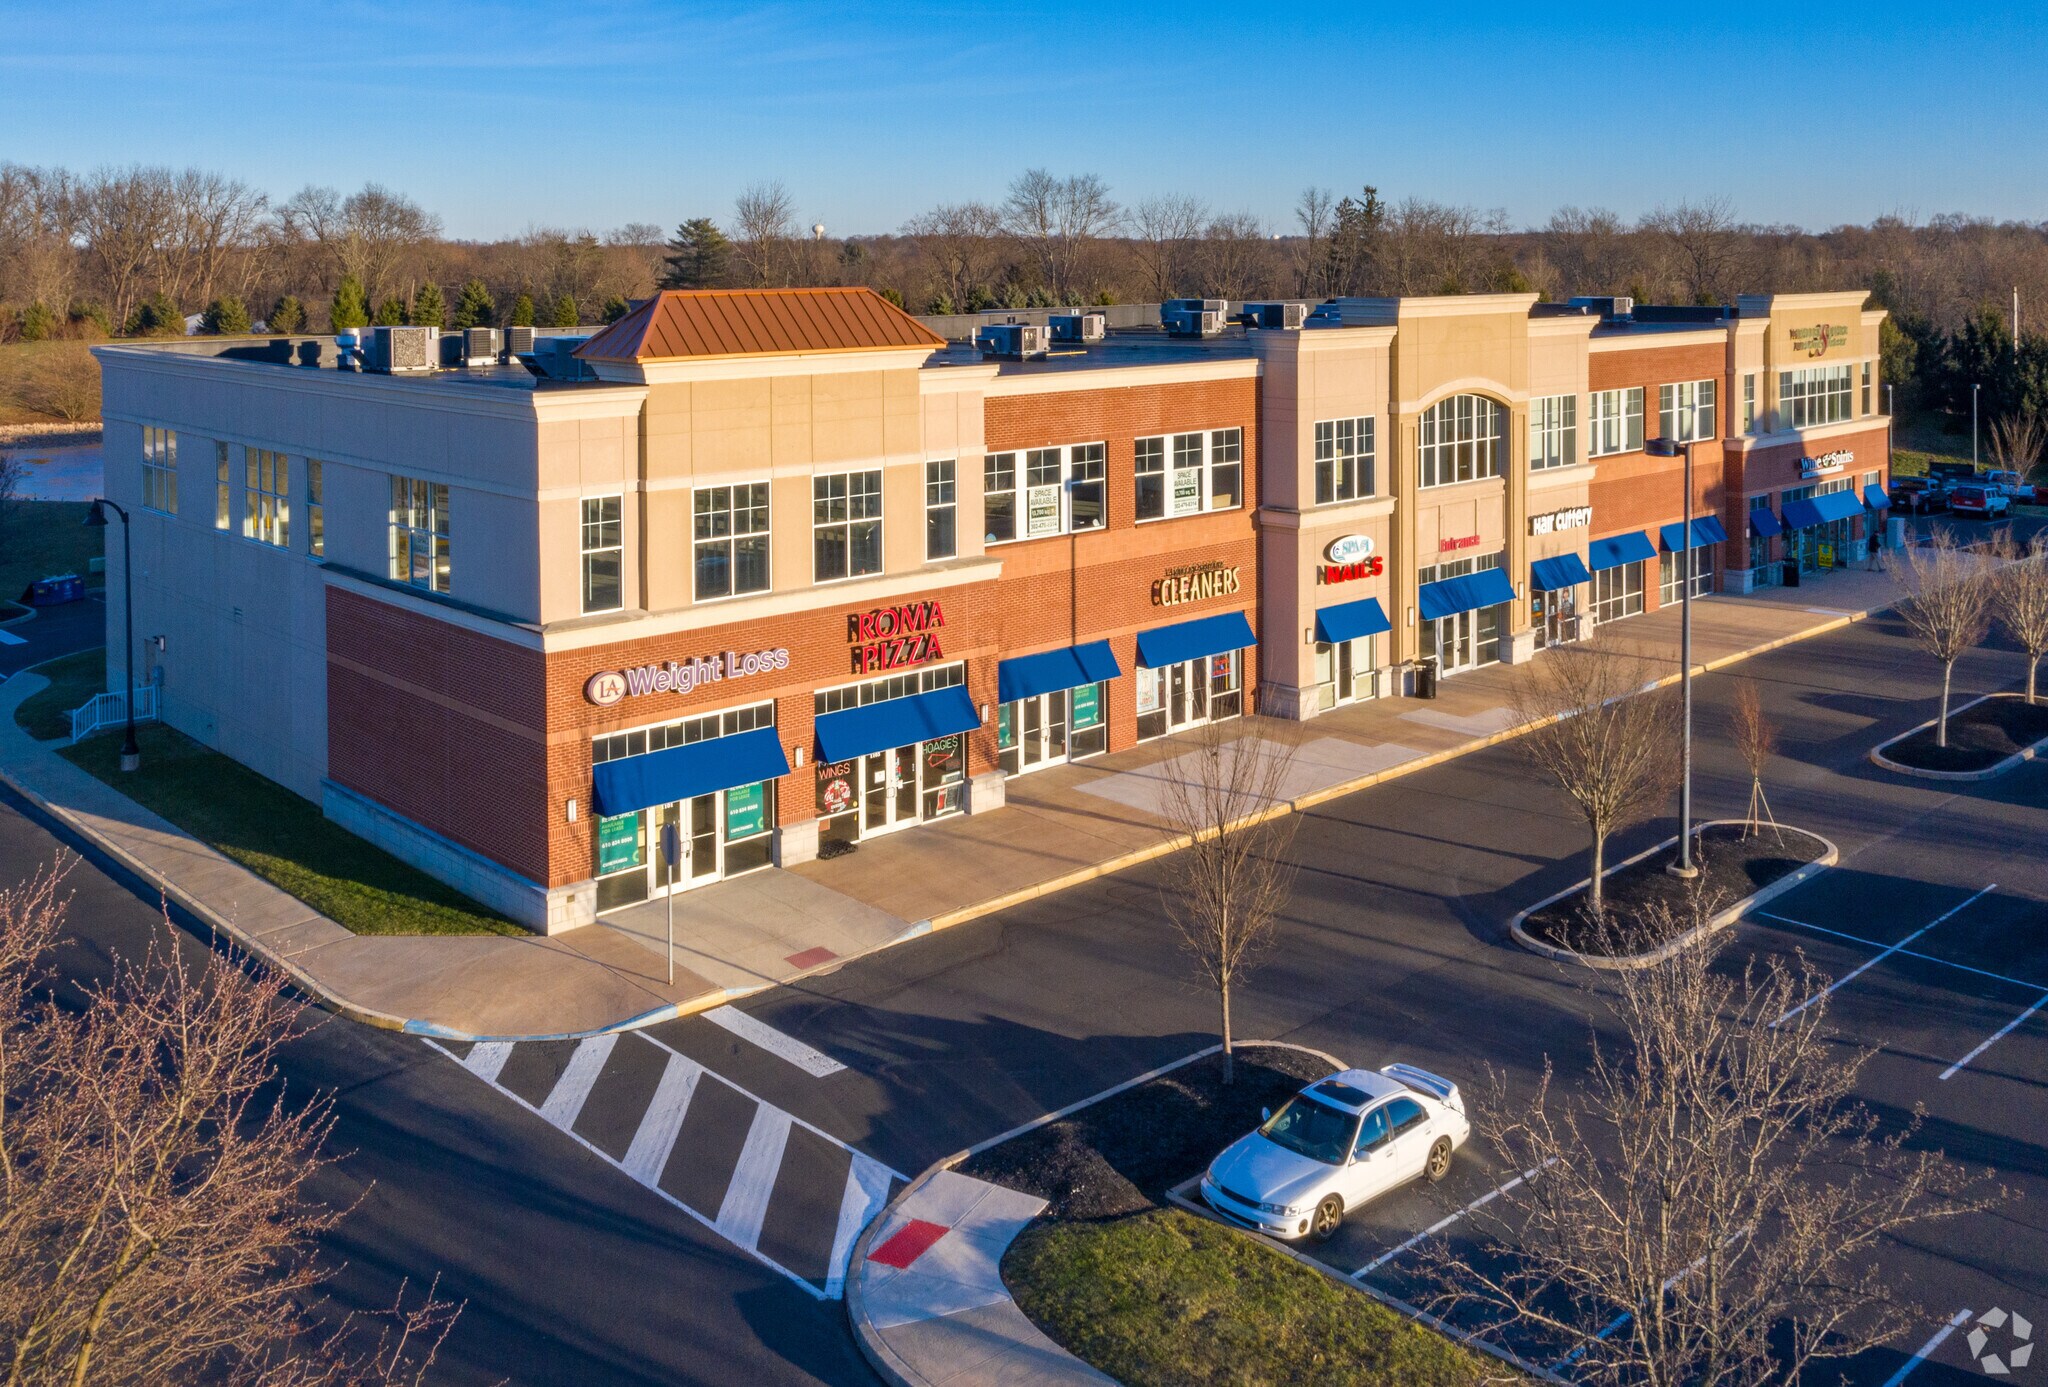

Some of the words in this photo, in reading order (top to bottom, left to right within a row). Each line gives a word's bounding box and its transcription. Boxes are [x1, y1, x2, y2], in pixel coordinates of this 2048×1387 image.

[1801, 457, 1821, 471] Wine
[1832, 450, 1854, 466] Spirits
[1174, 478, 1197, 487] AVAILABLE
[1177, 471, 1191, 479] SPACE
[1030, 496, 1057, 506] AVAILABLE
[1034, 489, 1052, 498] SPACE
[1533, 514, 1555, 536] Hair
[1342, 540, 1360, 554] SPA
[1440, 535, 1480, 552] Entrance
[1327, 556, 1383, 585] NAILS
[1161, 567, 1240, 607] CLEANERS
[859, 602, 945, 643] ROMA
[862, 633, 944, 674] PIZZA
[600, 679, 620, 699] LA
[627, 656, 722, 697] Weight
[725, 648, 789, 679] Loss
[923, 735, 959, 754] HOAGIES
[819, 762, 850, 780] WINGS
[602, 841, 611, 849] 610
